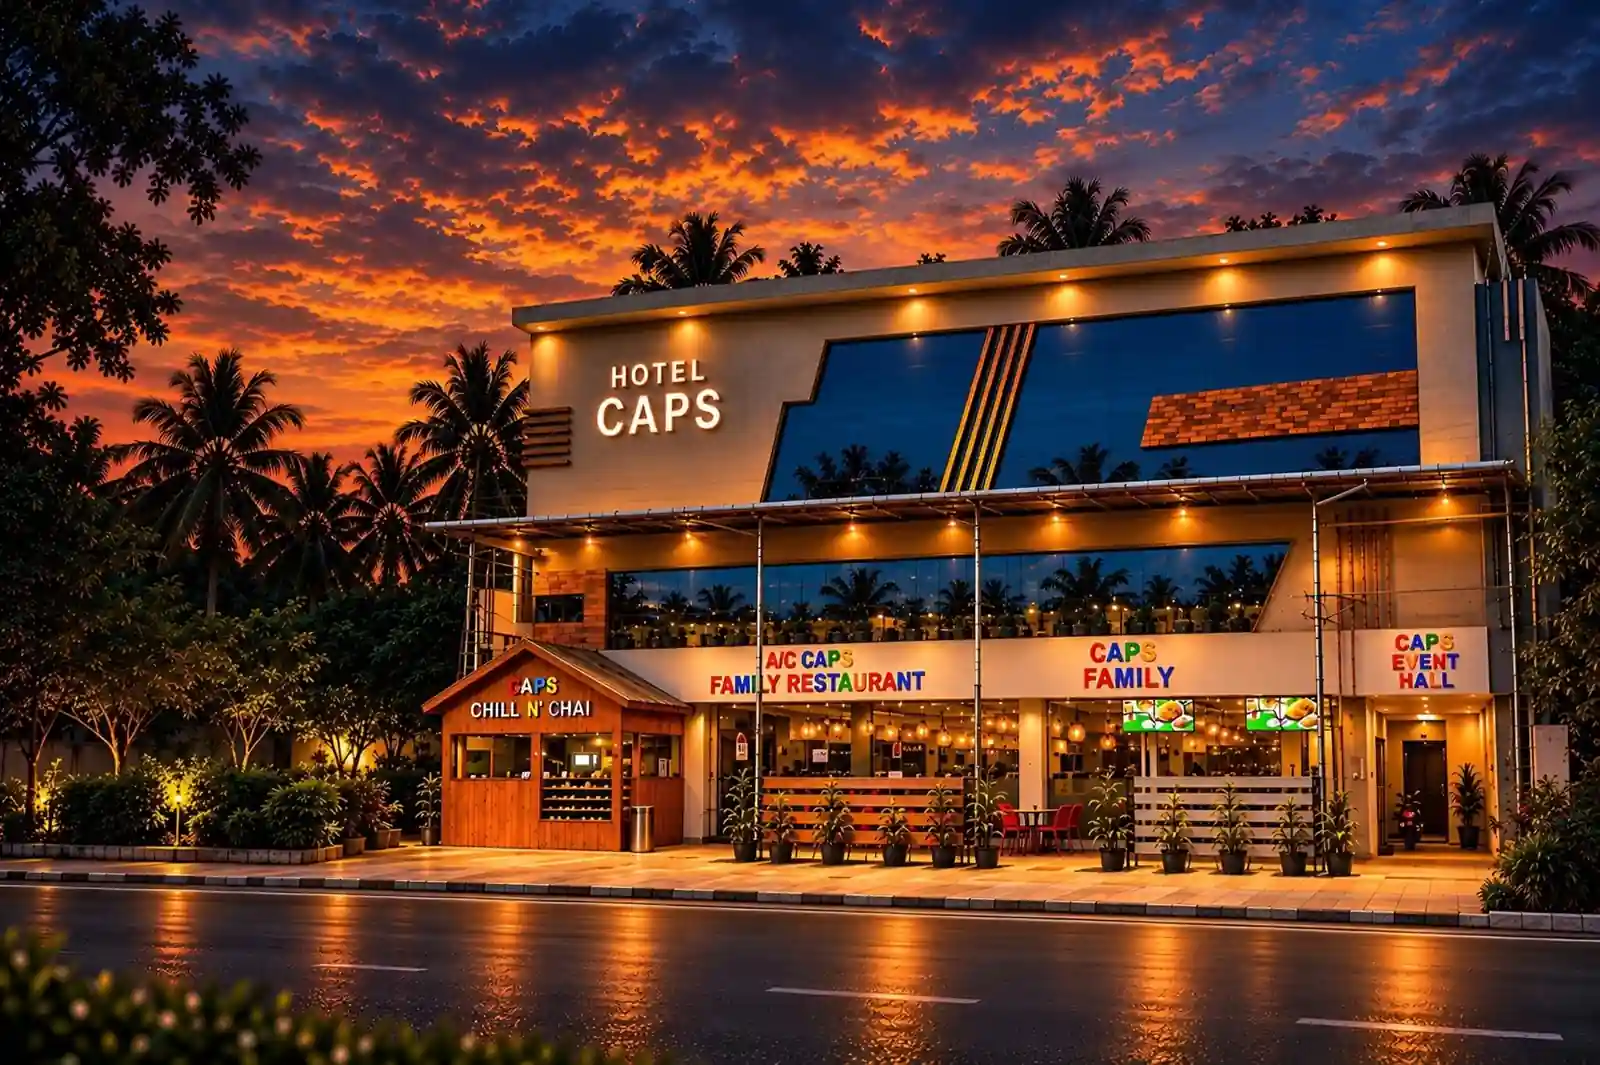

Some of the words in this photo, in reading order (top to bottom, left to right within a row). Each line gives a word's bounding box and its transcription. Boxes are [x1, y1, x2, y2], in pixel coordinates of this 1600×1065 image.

[610, 359, 705, 388] HOTEL
[596, 388, 721, 437] CAPS
[1090, 640, 1157, 663] CAPS
[1394, 633, 1454, 651] CAPS
[765, 651, 797, 669] A/C
[801, 650, 854, 669] CAPS
[1392, 652, 1460, 671] EVENT
[507, 676, 559, 696] CAPS
[787, 671, 926, 693] RESTAURANT
[1083, 666, 1175, 689] FAMILY
[1399, 671, 1455, 689] HALL
[470, 701, 520, 718] CHILL
[527, 700, 544, 718] N'
[548, 700, 591, 717] CHAI
